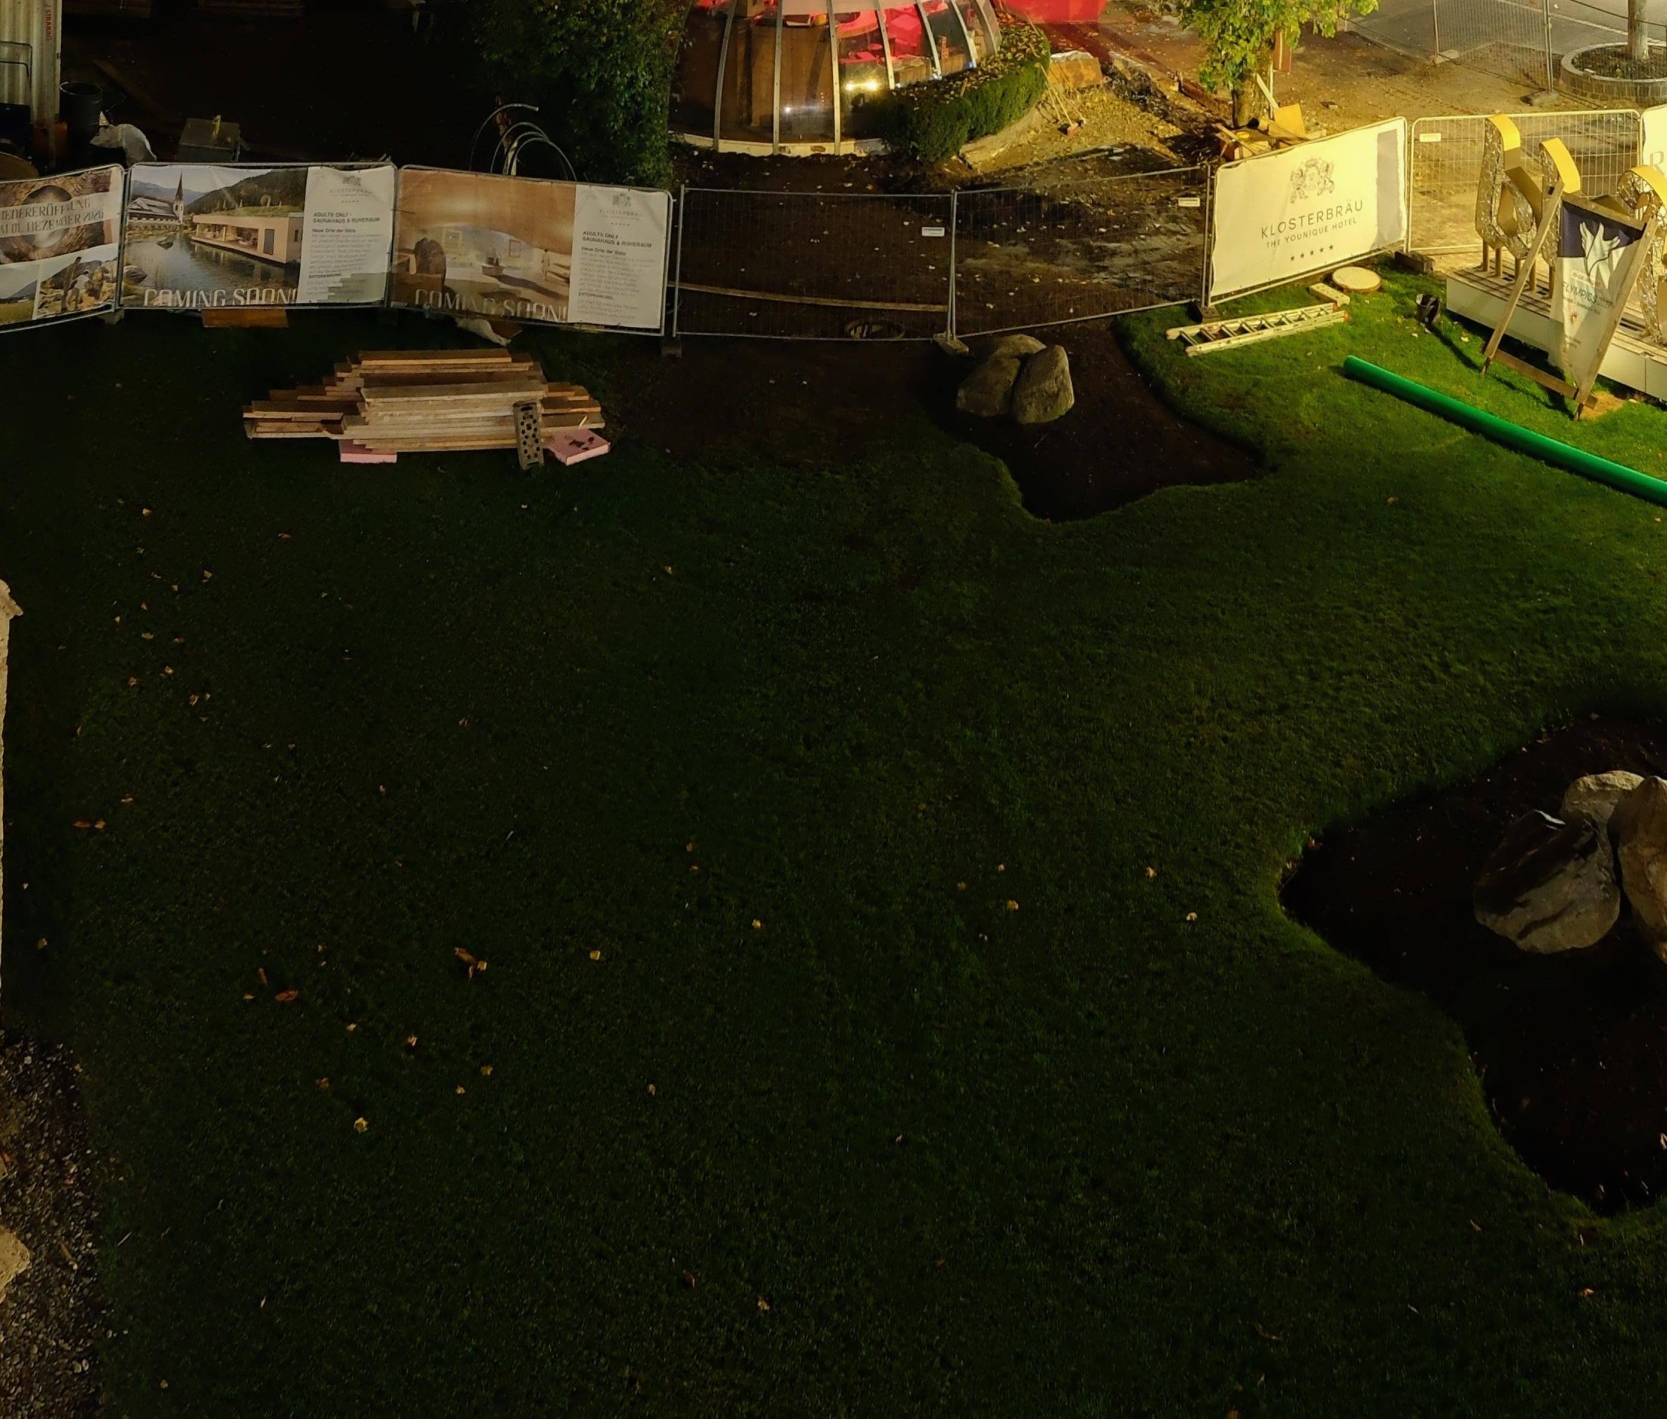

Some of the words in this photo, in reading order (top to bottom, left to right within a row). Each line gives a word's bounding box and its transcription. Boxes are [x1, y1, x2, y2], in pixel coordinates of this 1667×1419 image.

[1261, 199, 1363, 240] KLOSTERBRÄU
[1267, 237, 1281, 249] THE
[1284, 225, 1328, 243] YOUNIQUE
[1332, 217, 1357, 230] HOTEL
